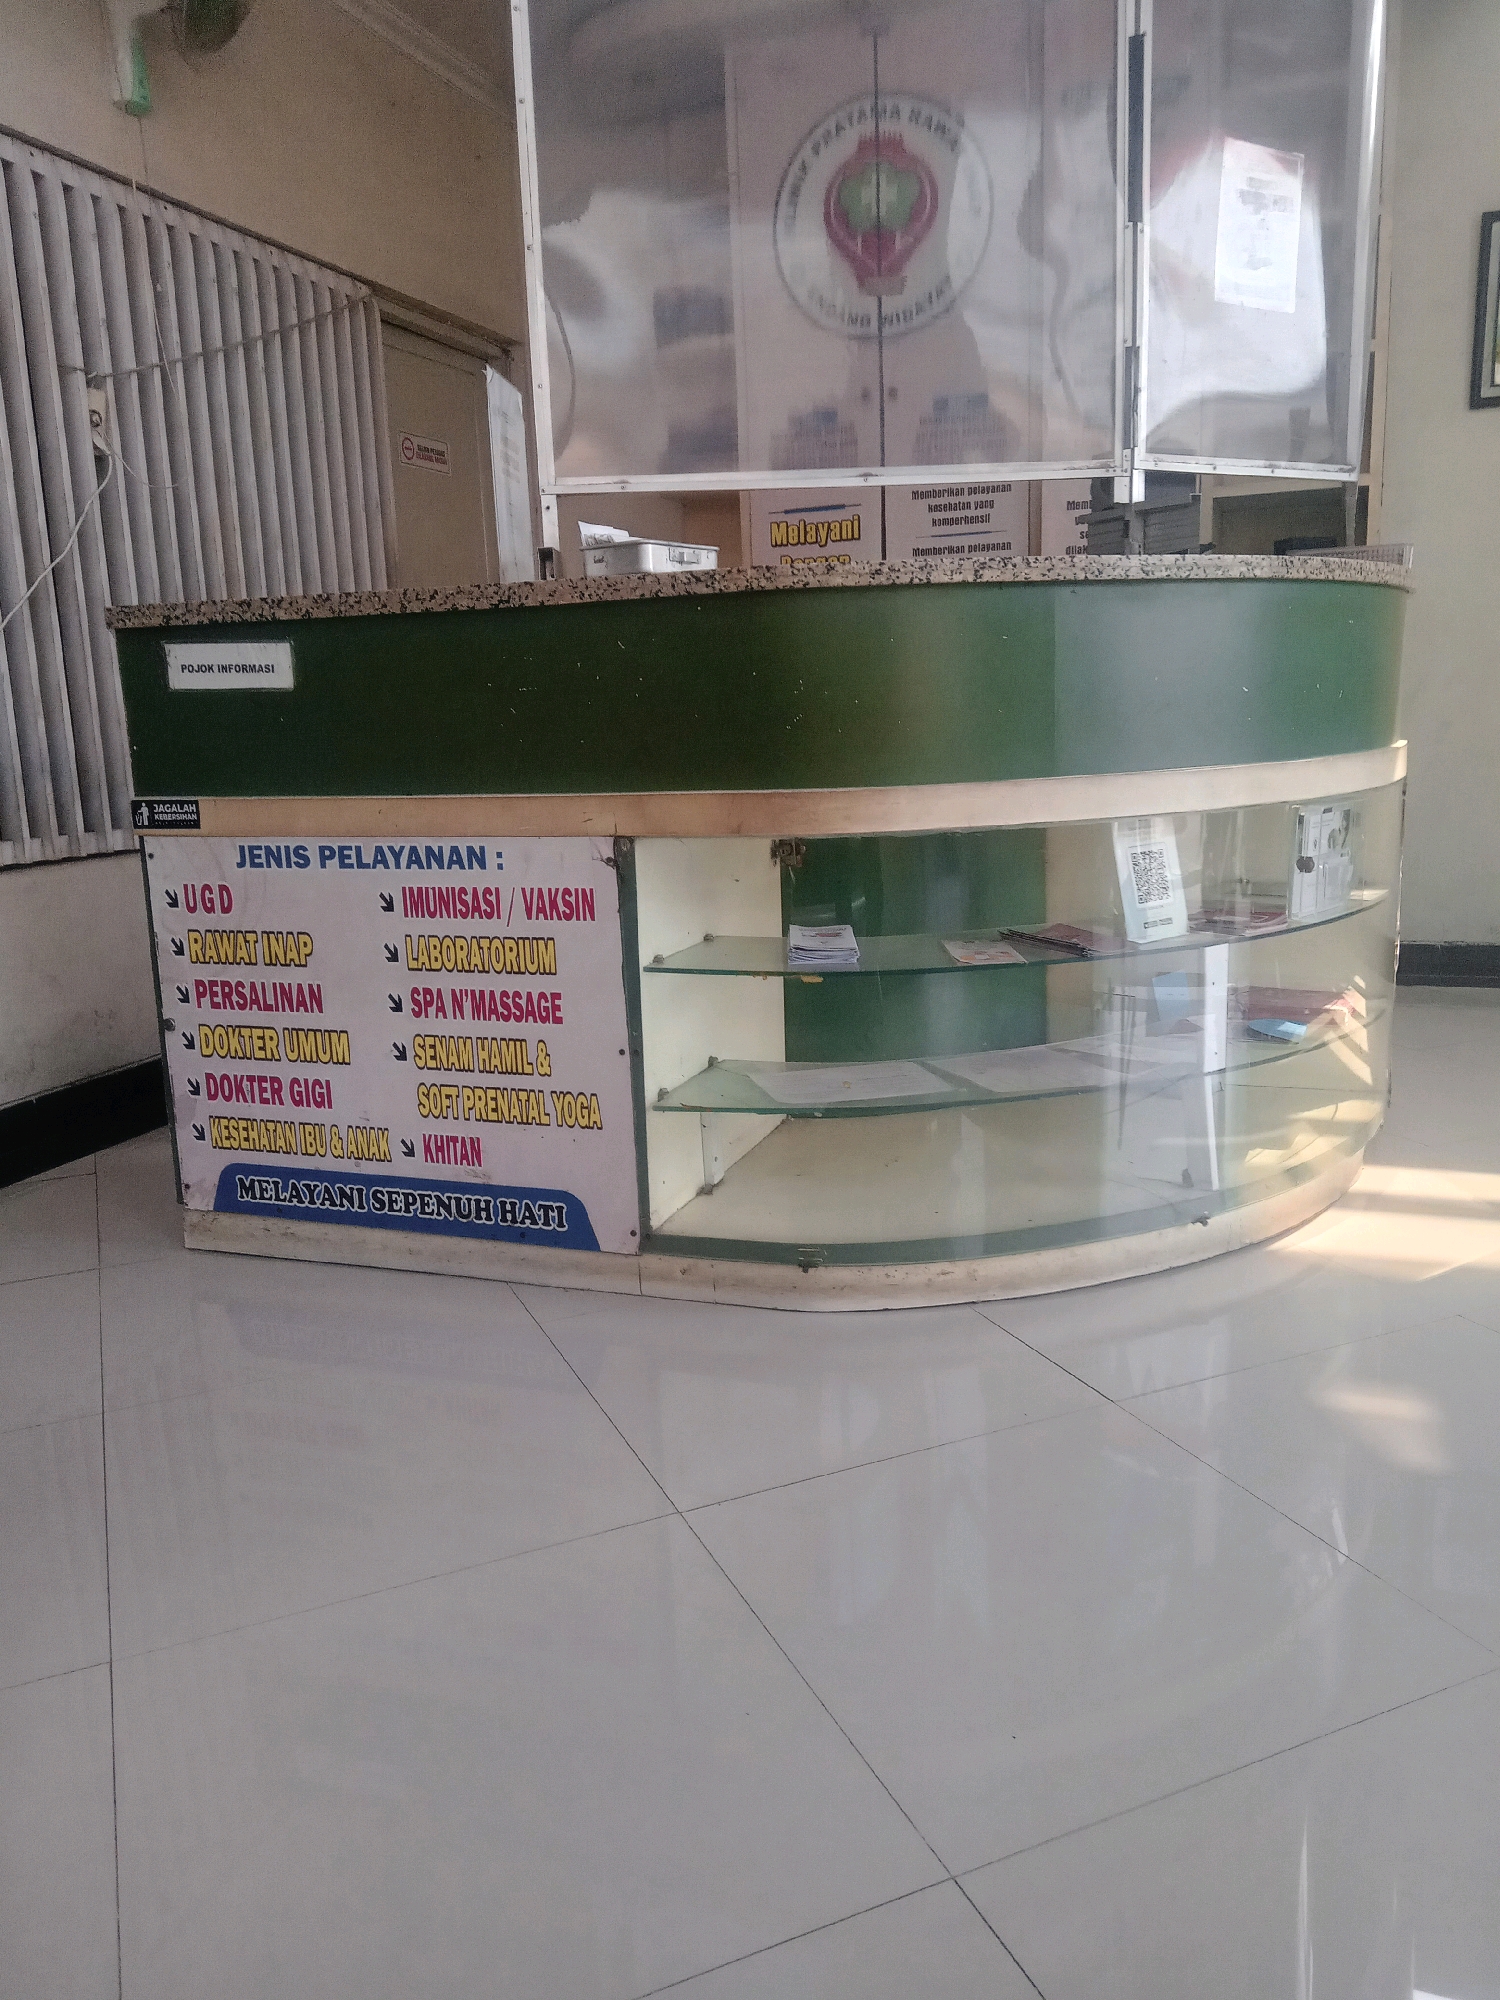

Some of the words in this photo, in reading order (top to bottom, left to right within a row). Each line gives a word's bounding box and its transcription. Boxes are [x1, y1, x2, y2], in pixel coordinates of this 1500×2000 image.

[911, 485, 965, 500] Memberikan
[967, 483, 1012, 498] pelayanan
[928, 501, 971, 513] kesehatan
[974, 499, 995, 513] yang
[770, 514, 861, 548] Melayani
[932, 513, 992, 527] komperhensif
[912, 543, 965, 557] Memberikan
[967, 541, 1012, 555] pelayanan
[181, 664, 215, 674] POJOK
[217, 663, 275, 674] INFORMASI
[153, 803, 197, 813] JAGALAH
[154, 813, 198, 821] KEBERSIHAN
[236, 845, 311, 869] JENIS
[318, 845, 487, 870] PELAYANAN
[183, 883, 234, 915] UGD
[401, 886, 501, 921] IMUNISASI
[506, 887, 515, 927] /
[521, 887, 596, 921] VAKSIN
[187, 929, 258, 966] RAWAT
[261, 930, 313, 967] INAP
[404, 934, 557, 975] LABORATORIUM
[194, 979, 323, 1014] PERSALINAN
[410, 986, 448, 1020] SPA
[198, 1023, 281, 1061] DOKTER
[283, 1027, 351, 1065] UMUM
[413, 1033, 474, 1073] SENAM
[476, 1037, 534, 1076] HAMIL
[536, 1040, 552, 1077] &
[205, 1072, 284, 1106] DOKTER
[289, 1076, 333, 1109] GIGI
[417, 1082, 460, 1120] SOFT
[461, 1086, 550, 1127] PRENATAL
[551, 1090, 603, 1130] YOGA
[209, 1115, 297, 1155] KESEHATAN
[299, 1121, 327, 1158] IBU
[330, 1124, 345, 1159] &
[346, 1125, 392, 1163] ANAK
[422, 1133, 483, 1168] KHITAN
[236, 1176, 367, 1212] MELAYANI
[371, 1188, 493, 1222] SEPENUH
[498, 1200, 567, 1229] HATI
